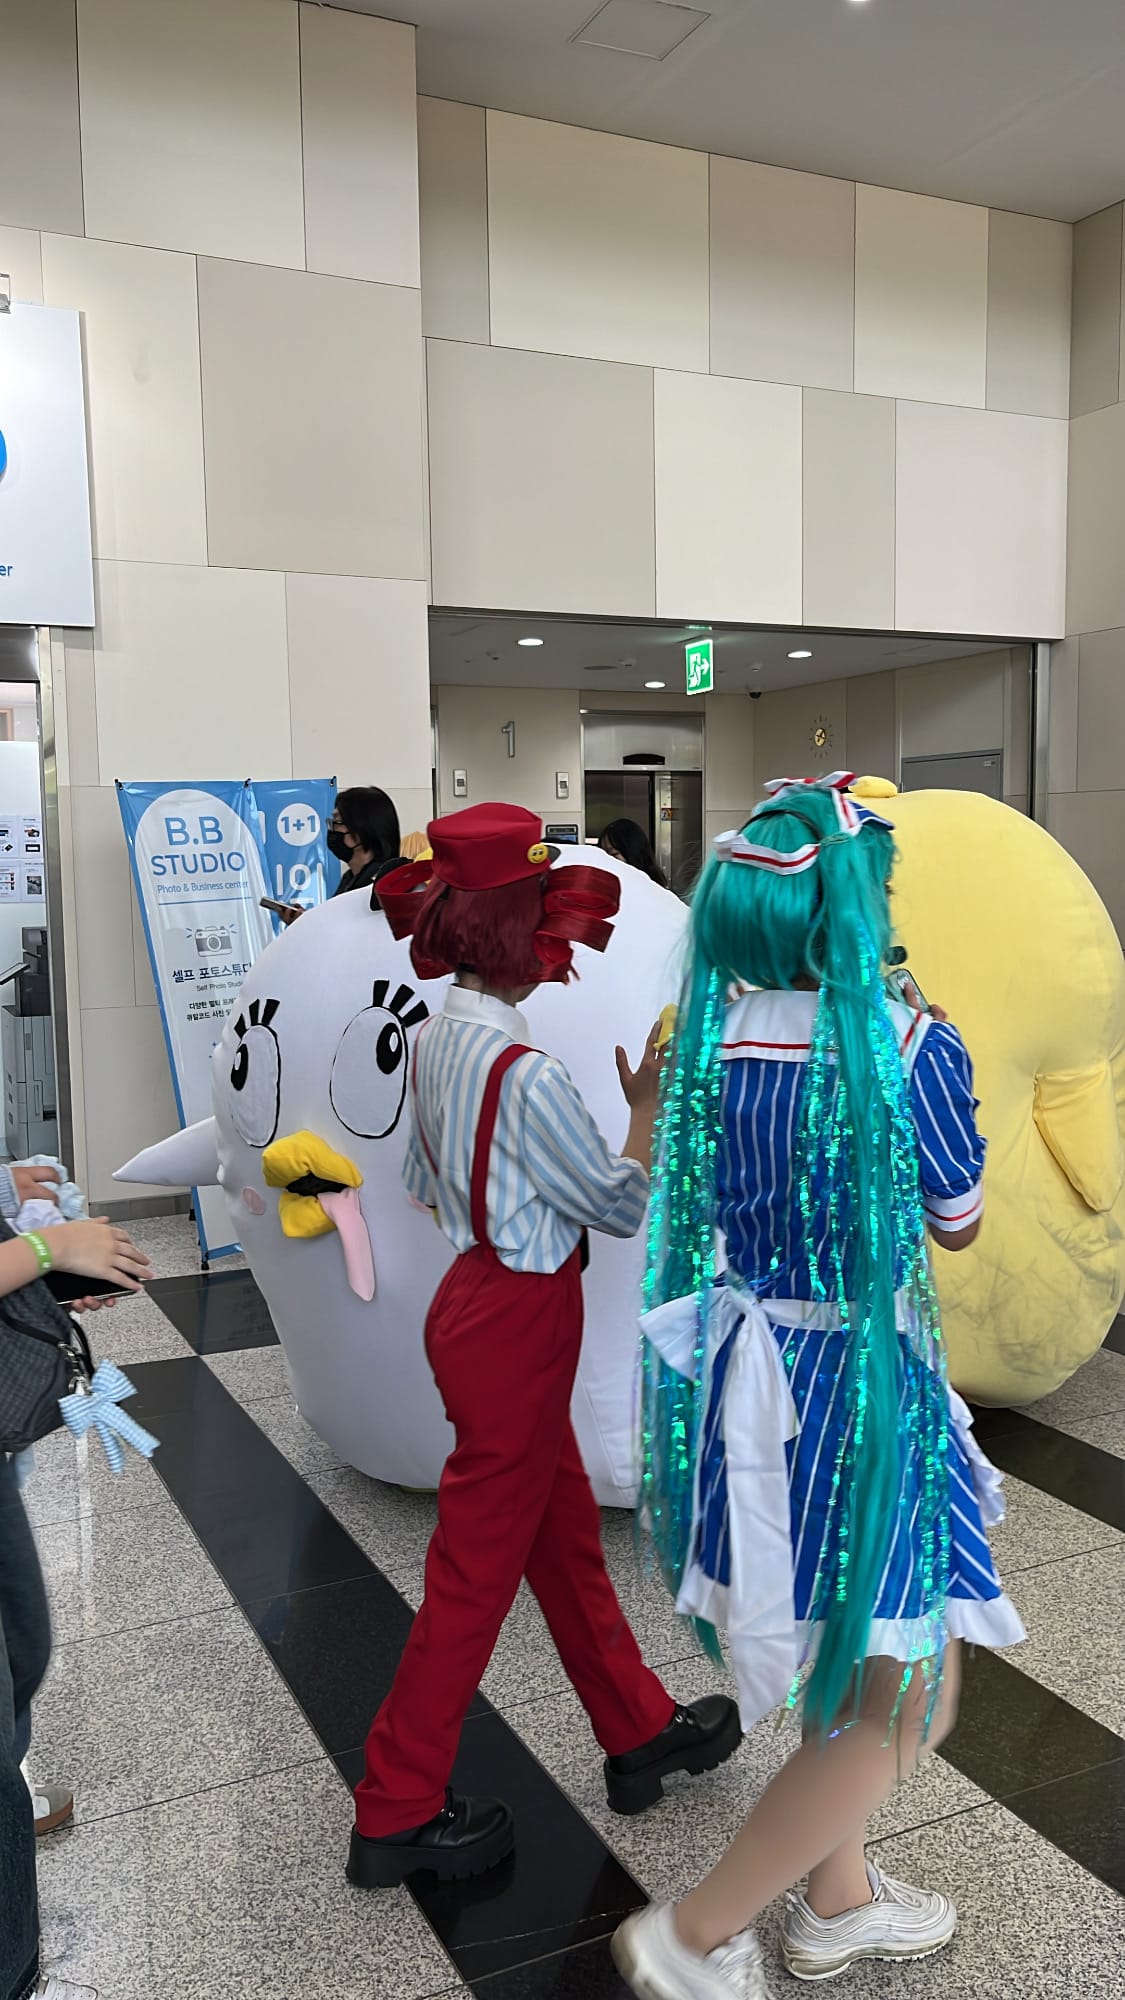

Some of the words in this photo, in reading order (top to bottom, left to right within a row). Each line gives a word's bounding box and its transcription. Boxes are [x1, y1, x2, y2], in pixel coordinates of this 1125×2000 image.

[501, 720, 515, 758] 1
[164, 816, 223, 846] B.B
[281, 815, 316, 834] 1+1
[151, 851, 246, 876] STUDIO
[157, 884, 181, 893] Photo
[183, 883, 190, 891] &
[191, 882, 224, 891] Business
[224, 880, 249, 888] center
[172, 969, 196, 983] 셀프
